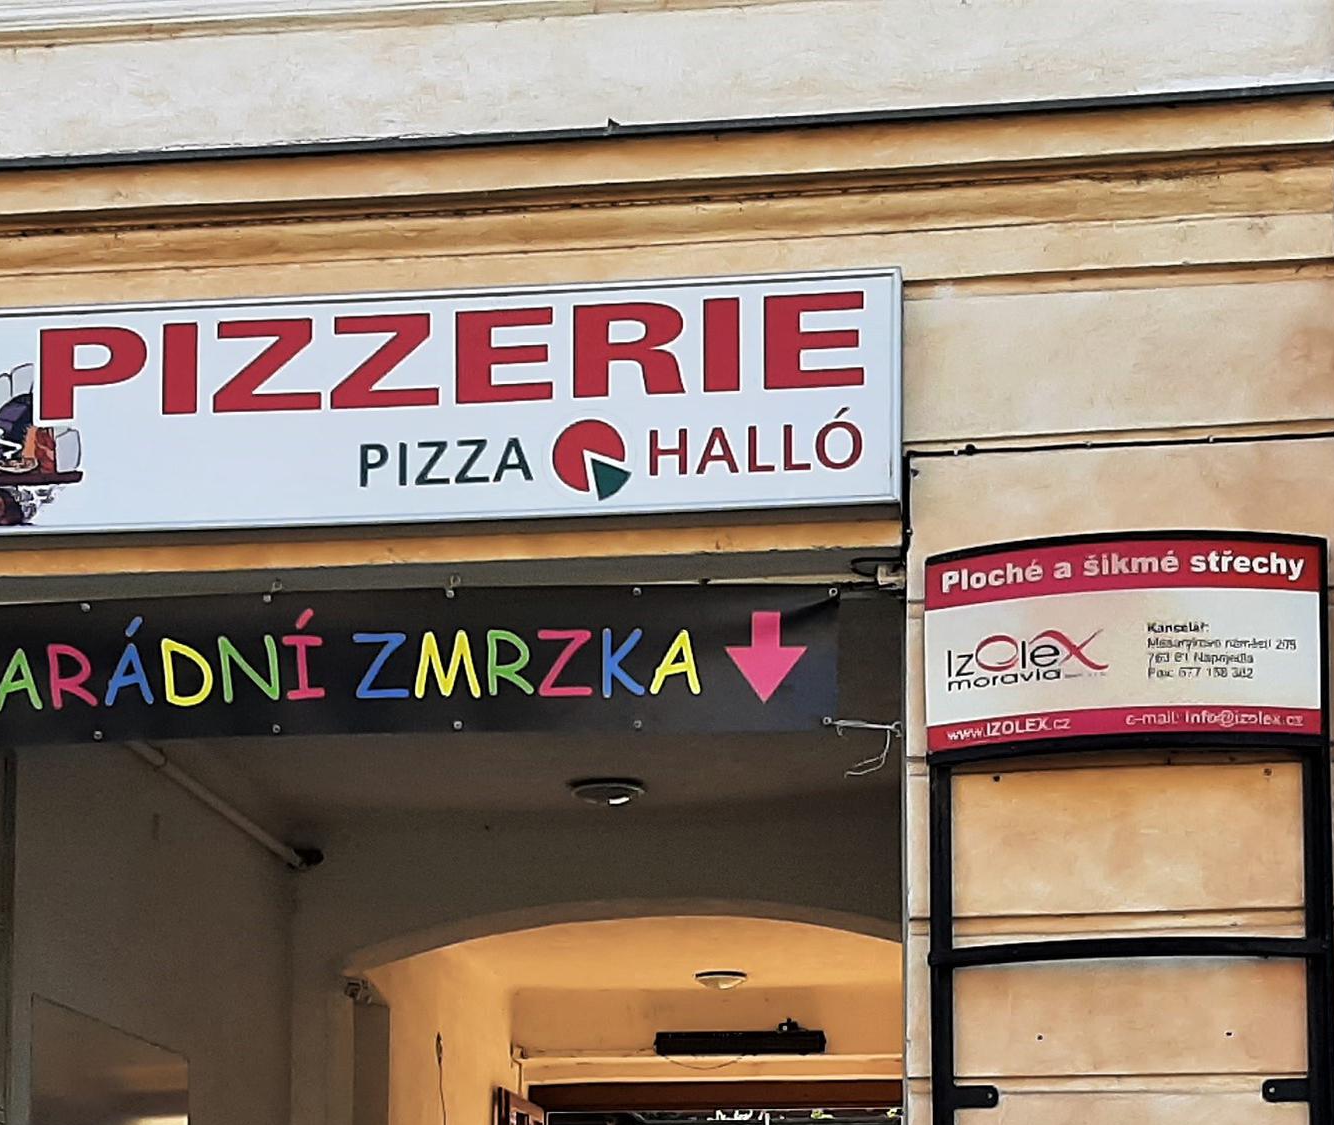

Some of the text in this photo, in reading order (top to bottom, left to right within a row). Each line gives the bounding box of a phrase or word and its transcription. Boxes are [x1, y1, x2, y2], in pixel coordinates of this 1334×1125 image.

[39, 289, 866, 421] PIZZERIE
[359, 406, 865, 488] PIZZA HALLÓ
[942, 549, 1306, 593] Ploché a šikmé střechy
[353, 627, 701, 701] ZMRZKA
[948, 668, 1061, 692] moravia
[947, 717, 1071, 741] www.IZOLEX.cz
